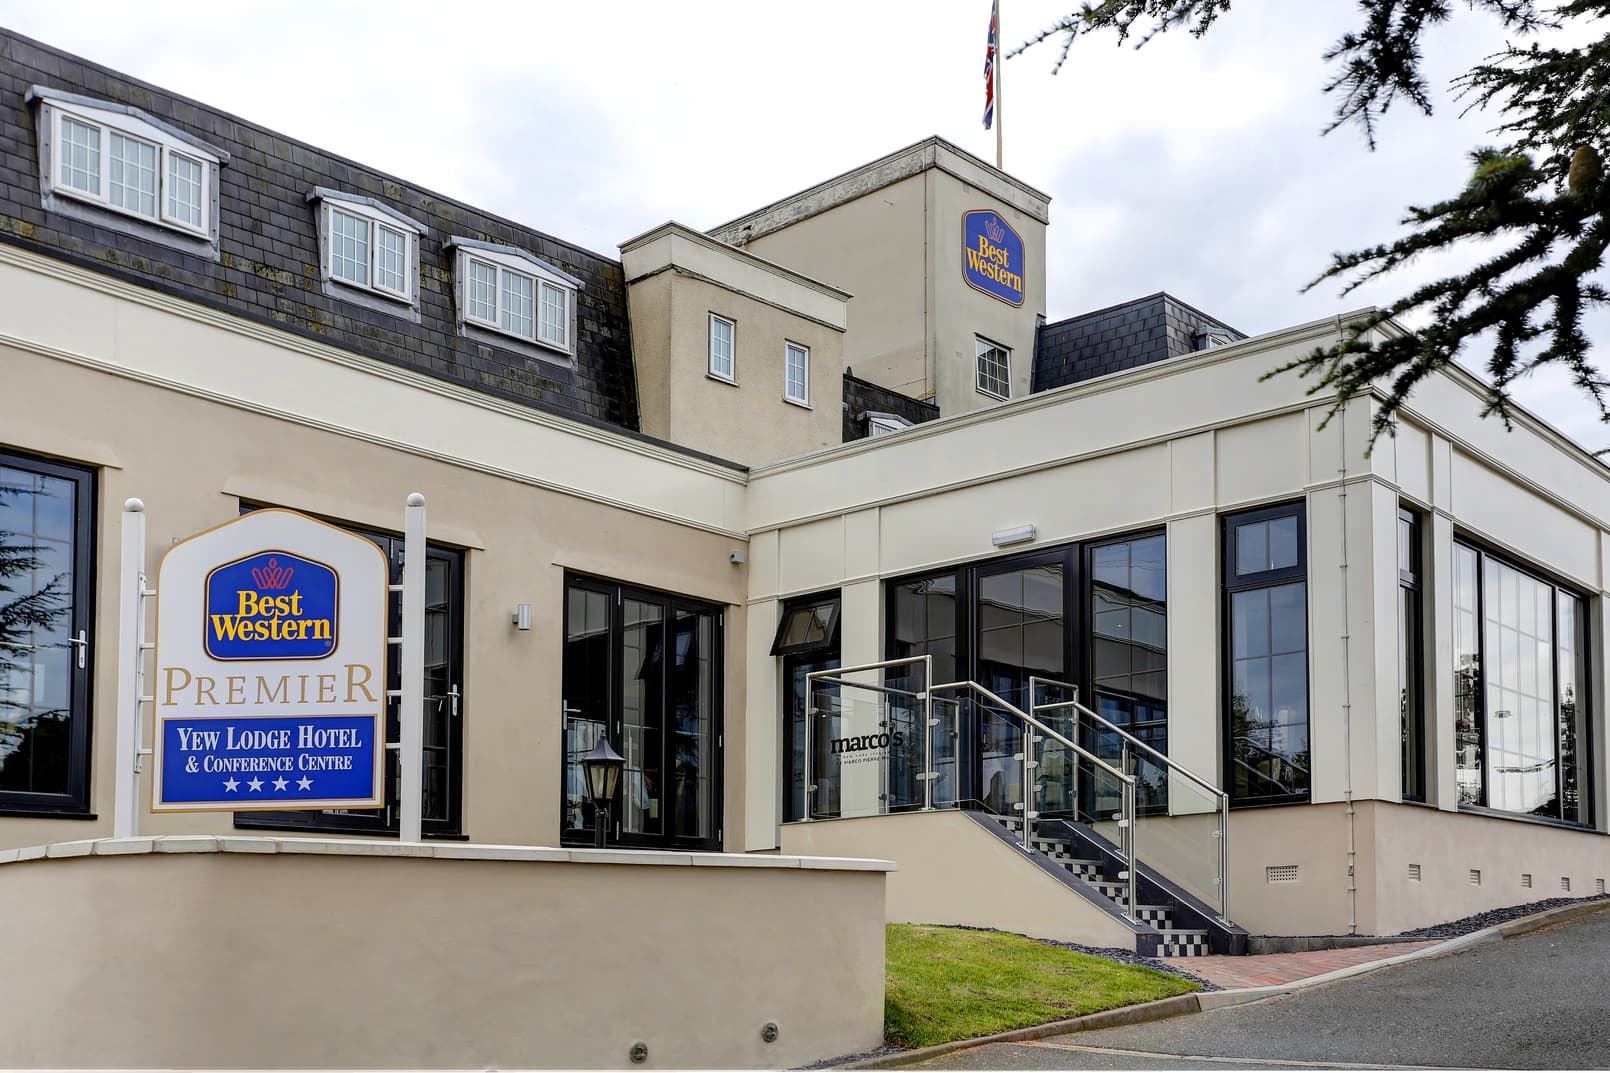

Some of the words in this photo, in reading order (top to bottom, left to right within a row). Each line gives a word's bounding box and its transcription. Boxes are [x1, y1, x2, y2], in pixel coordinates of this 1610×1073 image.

[978, 234, 1009, 268] Best
[966, 247, 1022, 292] Western
[236, 589, 304, 617] Best
[210, 612, 332, 641] Western
[162, 664, 378, 706] PREMIER
[176, 727, 221, 751] YEW
[226, 726, 291, 750] LODGE
[297, 725, 362, 749] HOTEL
[831, 727, 904, 753] marco's
[185, 755, 200, 773] &
[203, 755, 294, 773] CONFERENCE
[298, 753, 353, 771] CENTRE
